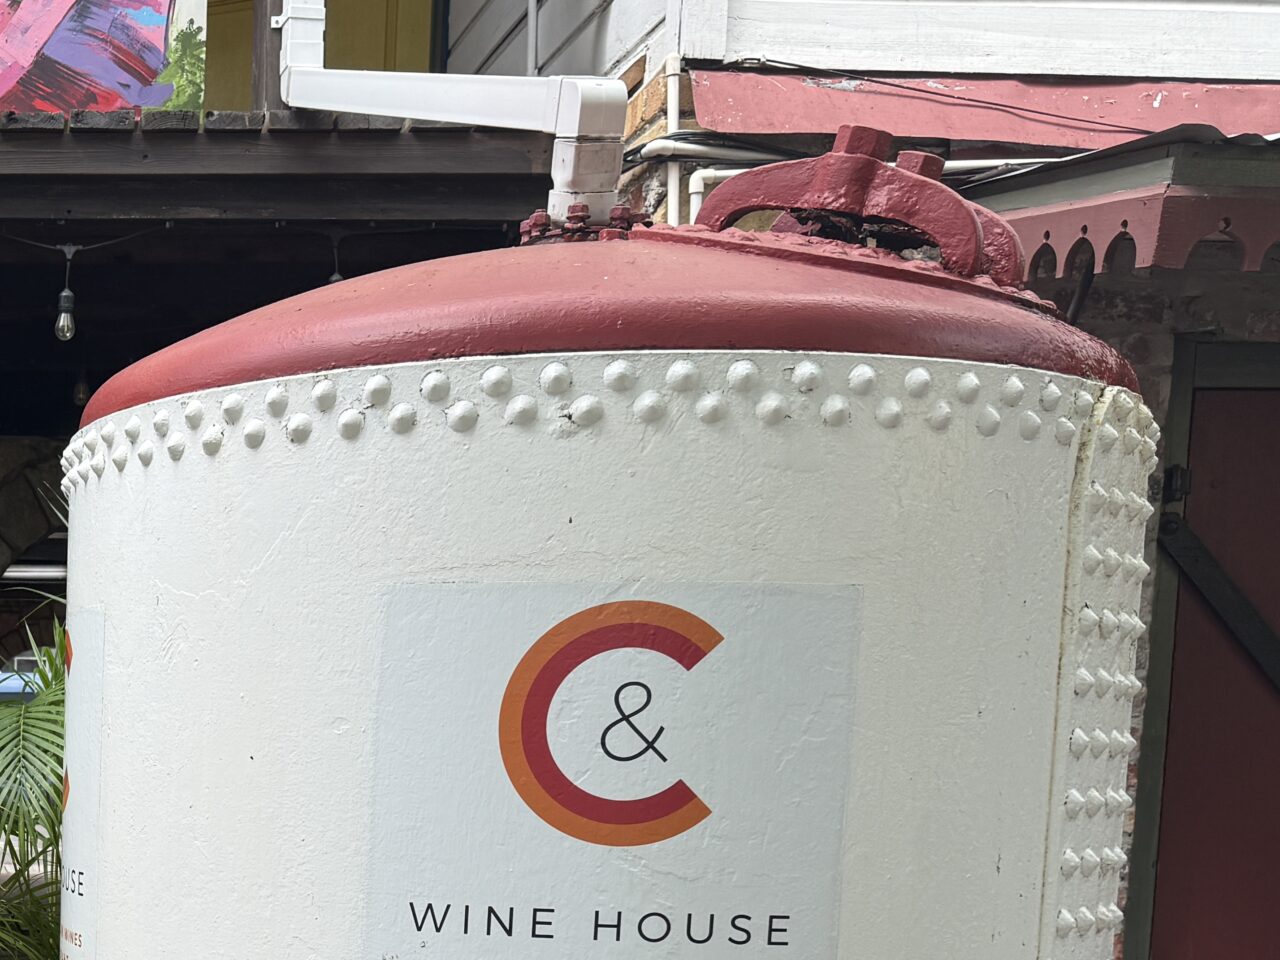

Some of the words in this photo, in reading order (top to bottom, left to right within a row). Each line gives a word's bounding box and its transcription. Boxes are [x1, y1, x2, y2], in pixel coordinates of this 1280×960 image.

[600, 681, 669, 763] &
[409, 901, 556, 940] WINE
[591, 909, 792, 947] HOUSE
